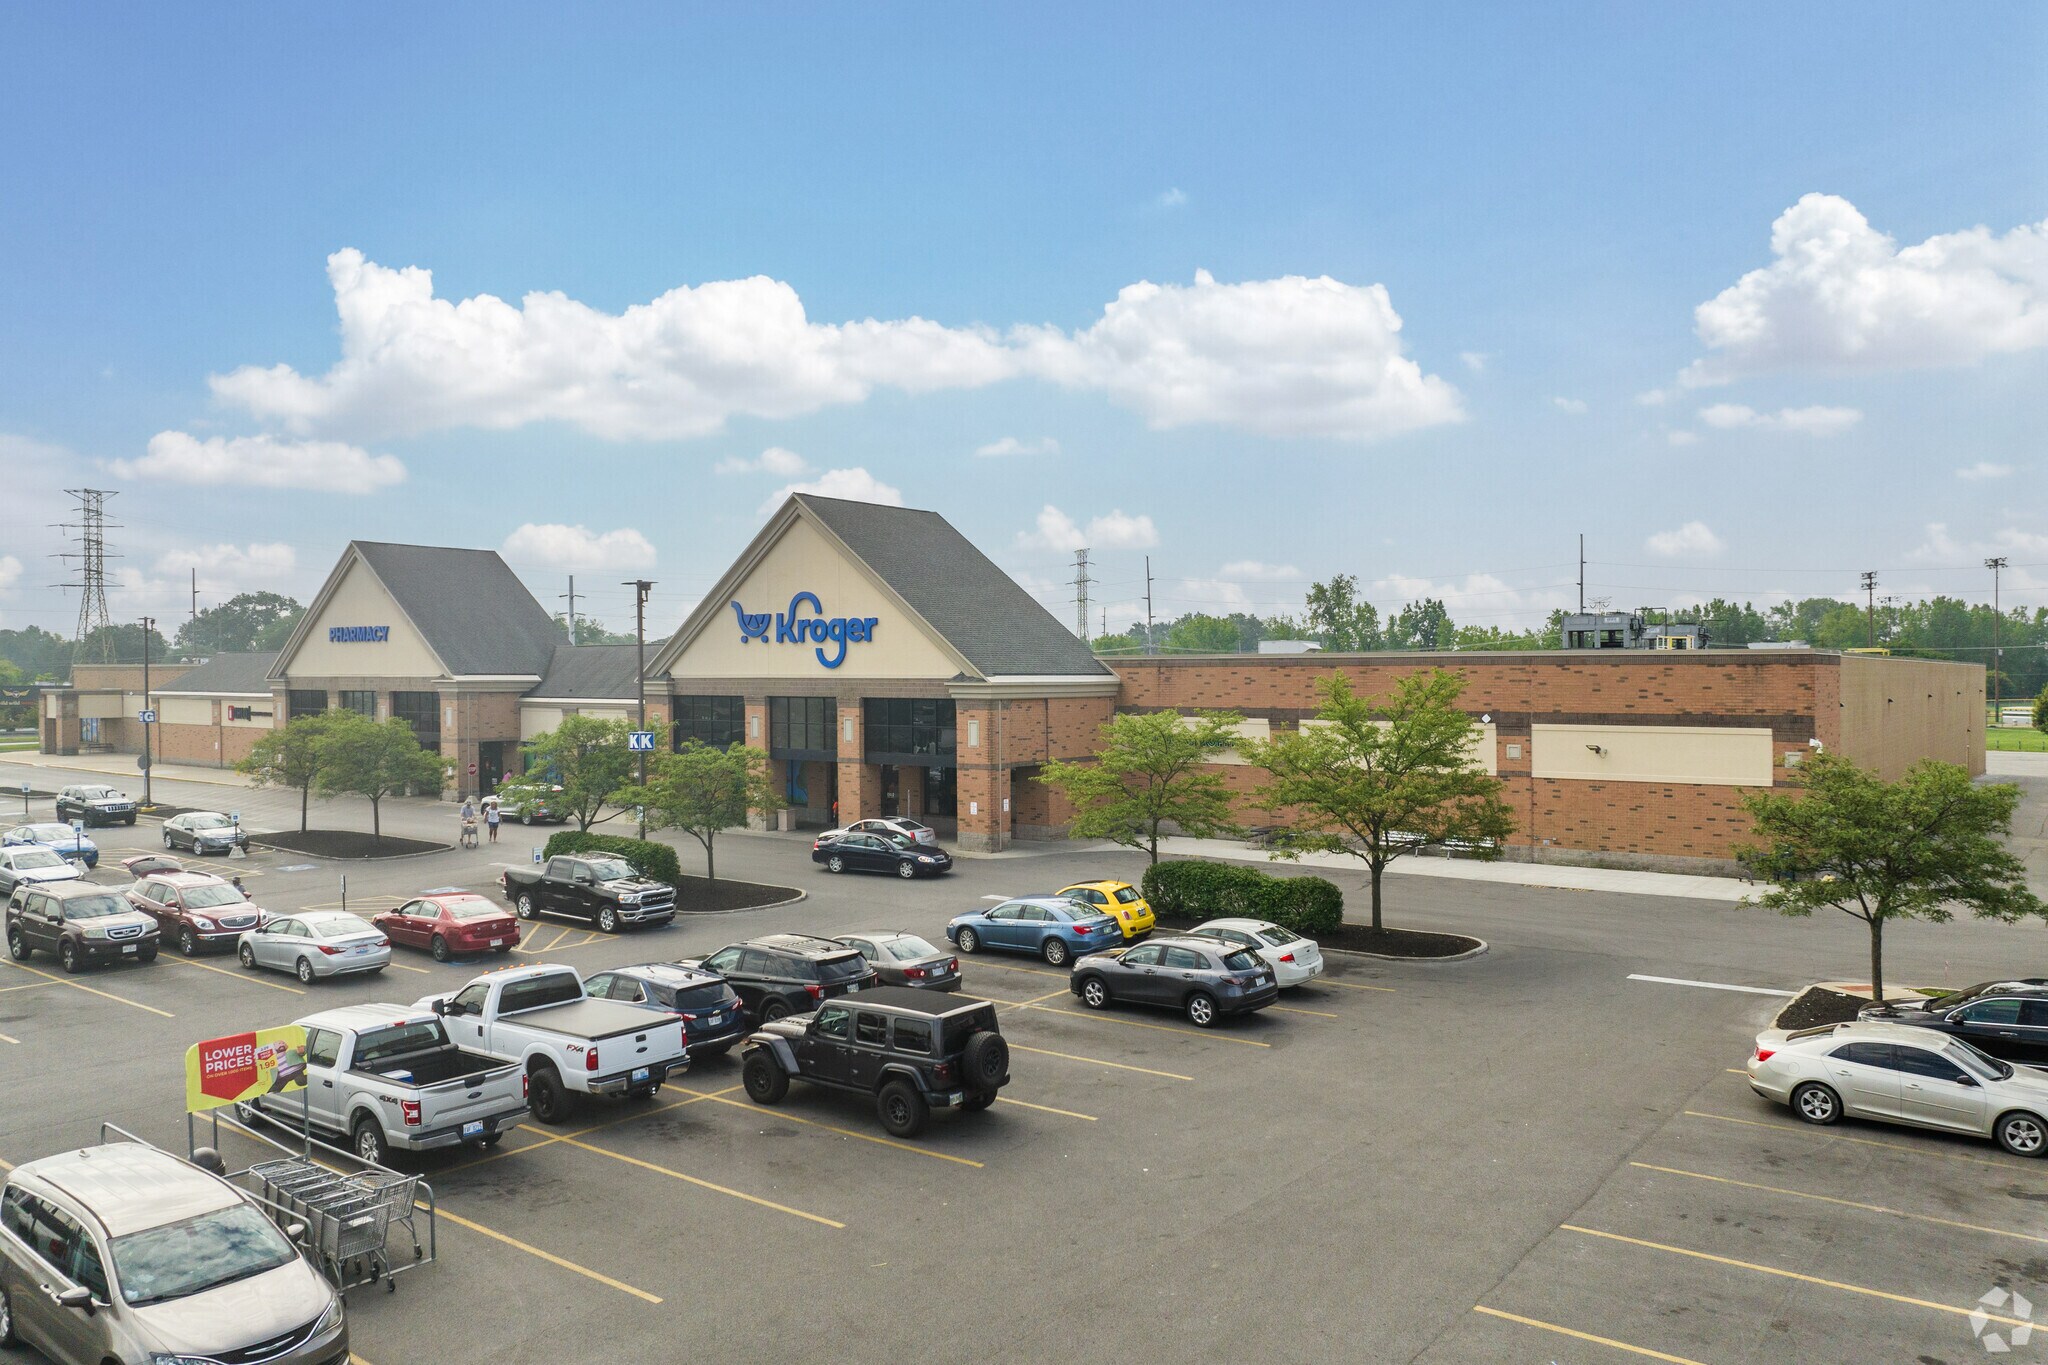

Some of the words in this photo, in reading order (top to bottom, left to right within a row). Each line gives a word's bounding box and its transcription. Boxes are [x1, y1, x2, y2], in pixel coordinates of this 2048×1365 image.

[329, 625, 390, 643] PHARMACY
[776, 591, 878, 669] Kroger
[204, 1044, 252, 1062] LOWER
[566, 1044, 584, 1053] FX4
[205, 1055, 253, 1073] PRICES
[259, 1060, 276, 1070] 1.99
